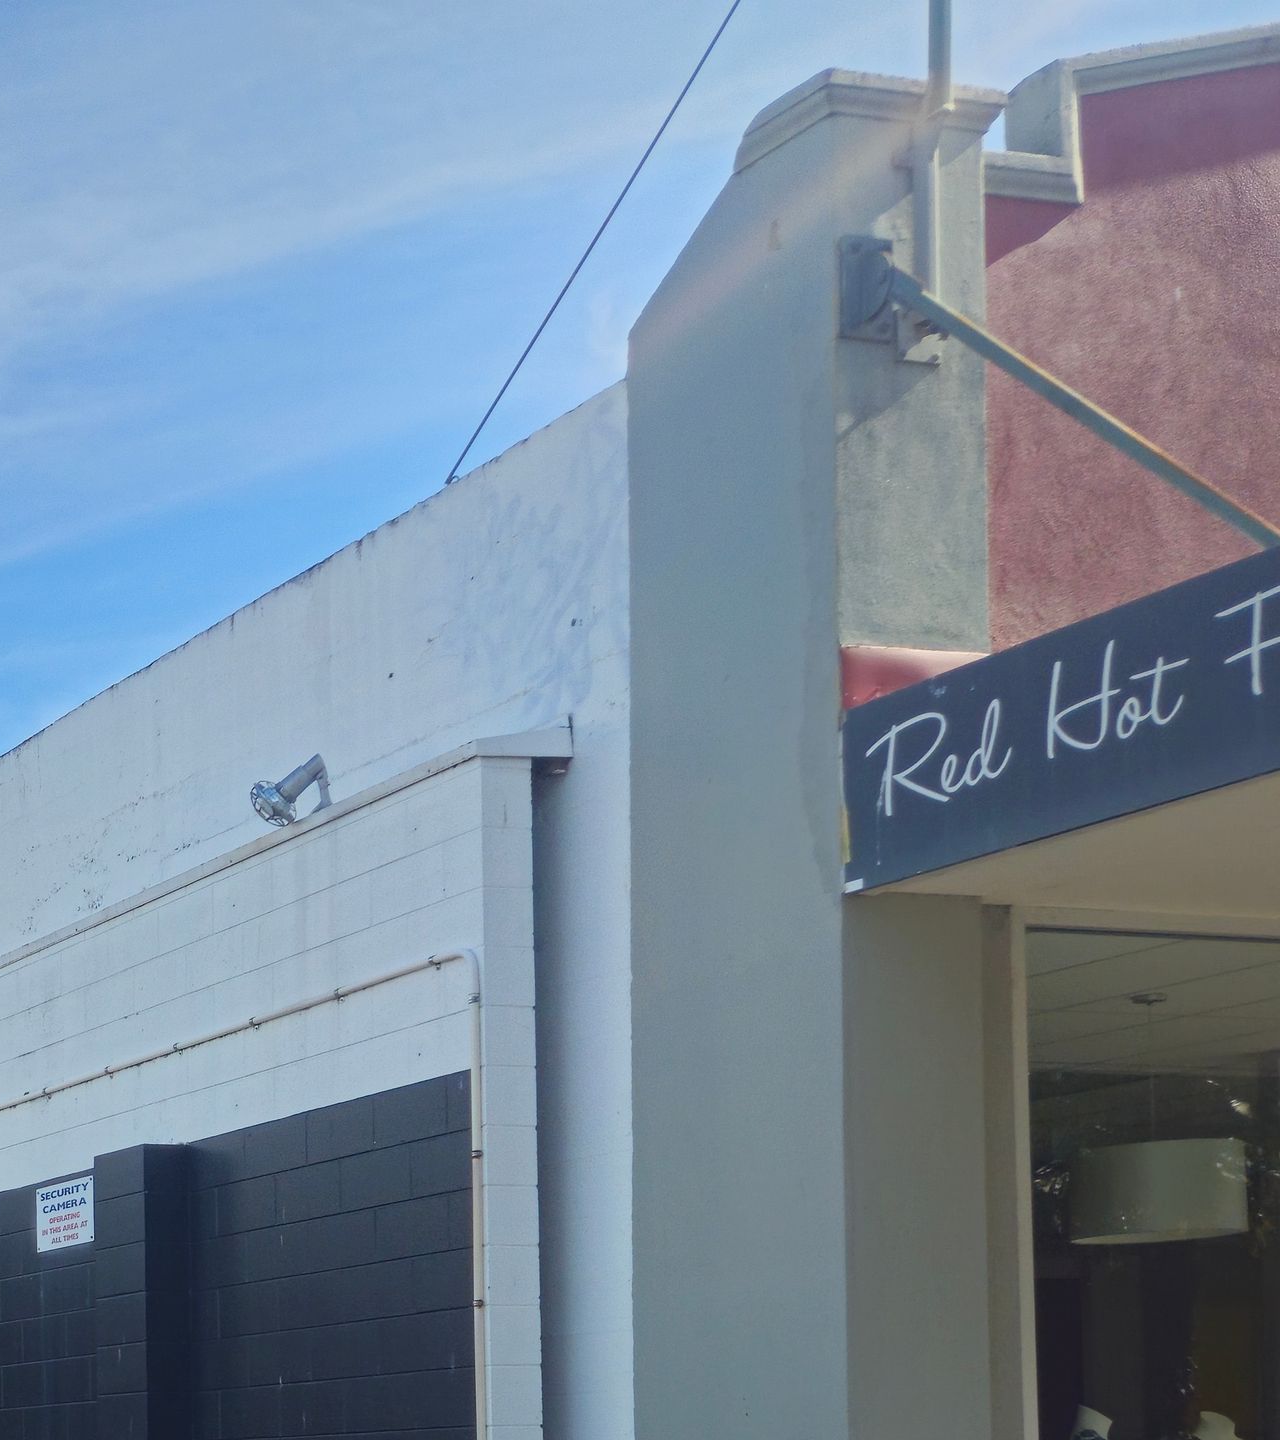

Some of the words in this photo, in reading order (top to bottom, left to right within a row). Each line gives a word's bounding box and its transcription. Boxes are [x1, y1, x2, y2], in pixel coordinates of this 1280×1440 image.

[865, 698, 1012, 817] Red
[1046, 639, 1191, 760] Hot
[40, 1182, 89, 1201] SECURITY
[42, 1197, 87, 1214] CAMERA
[49, 1211, 81, 1224] OPERATING
[49, 1226, 61, 1235] THIS
[63, 1222, 79, 1232] AREA
[80, 1220, 88, 1228] AT
[51, 1235, 62, 1244] ALL
[63, 1232, 79, 1242] TIMES
